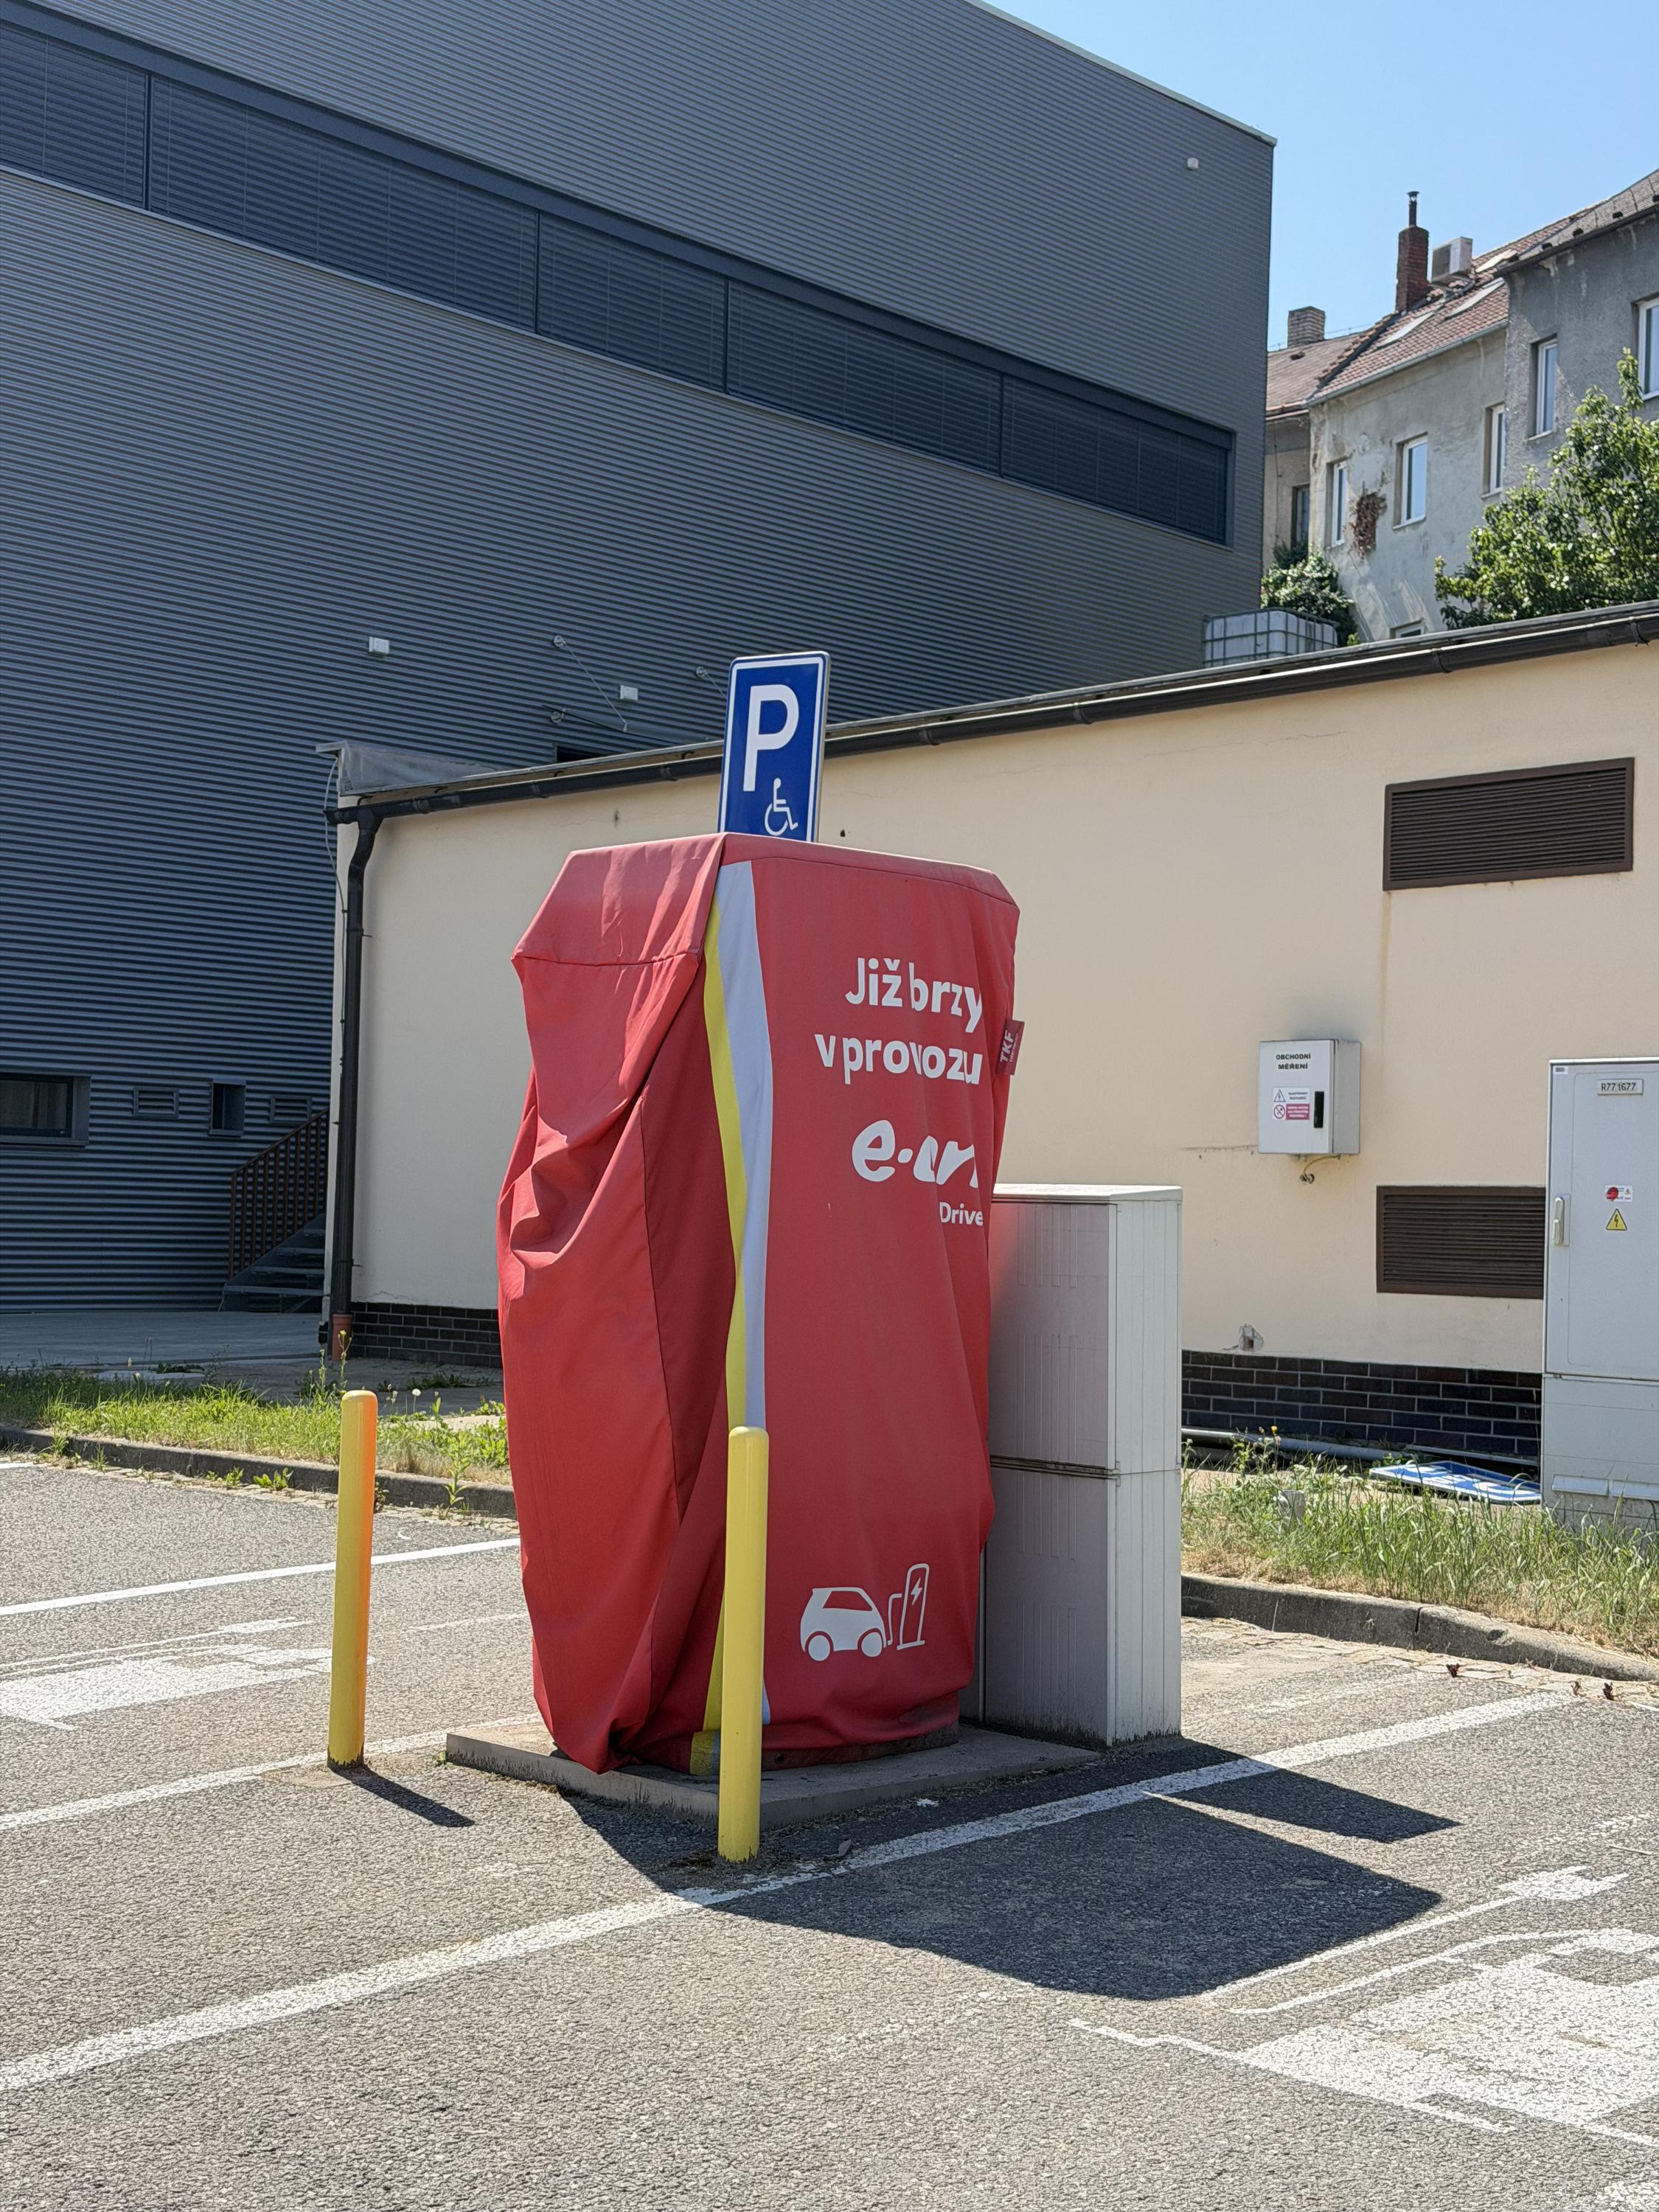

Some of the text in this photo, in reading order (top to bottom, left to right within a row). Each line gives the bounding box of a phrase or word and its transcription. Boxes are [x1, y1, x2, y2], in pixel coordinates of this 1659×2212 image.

[743, 684, 799, 792] P
[845, 958, 983, 1033] Již brzy
[814, 1034, 835, 1068] v
[843, 1037, 983, 1085] provozu
[1000, 1029, 1014, 1062] TKF
[1276, 1051, 1311, 1060] OBCHODNÍ
[1601, 1082, 1636, 1091] R771677
[939, 1202, 984, 1226] Drive
